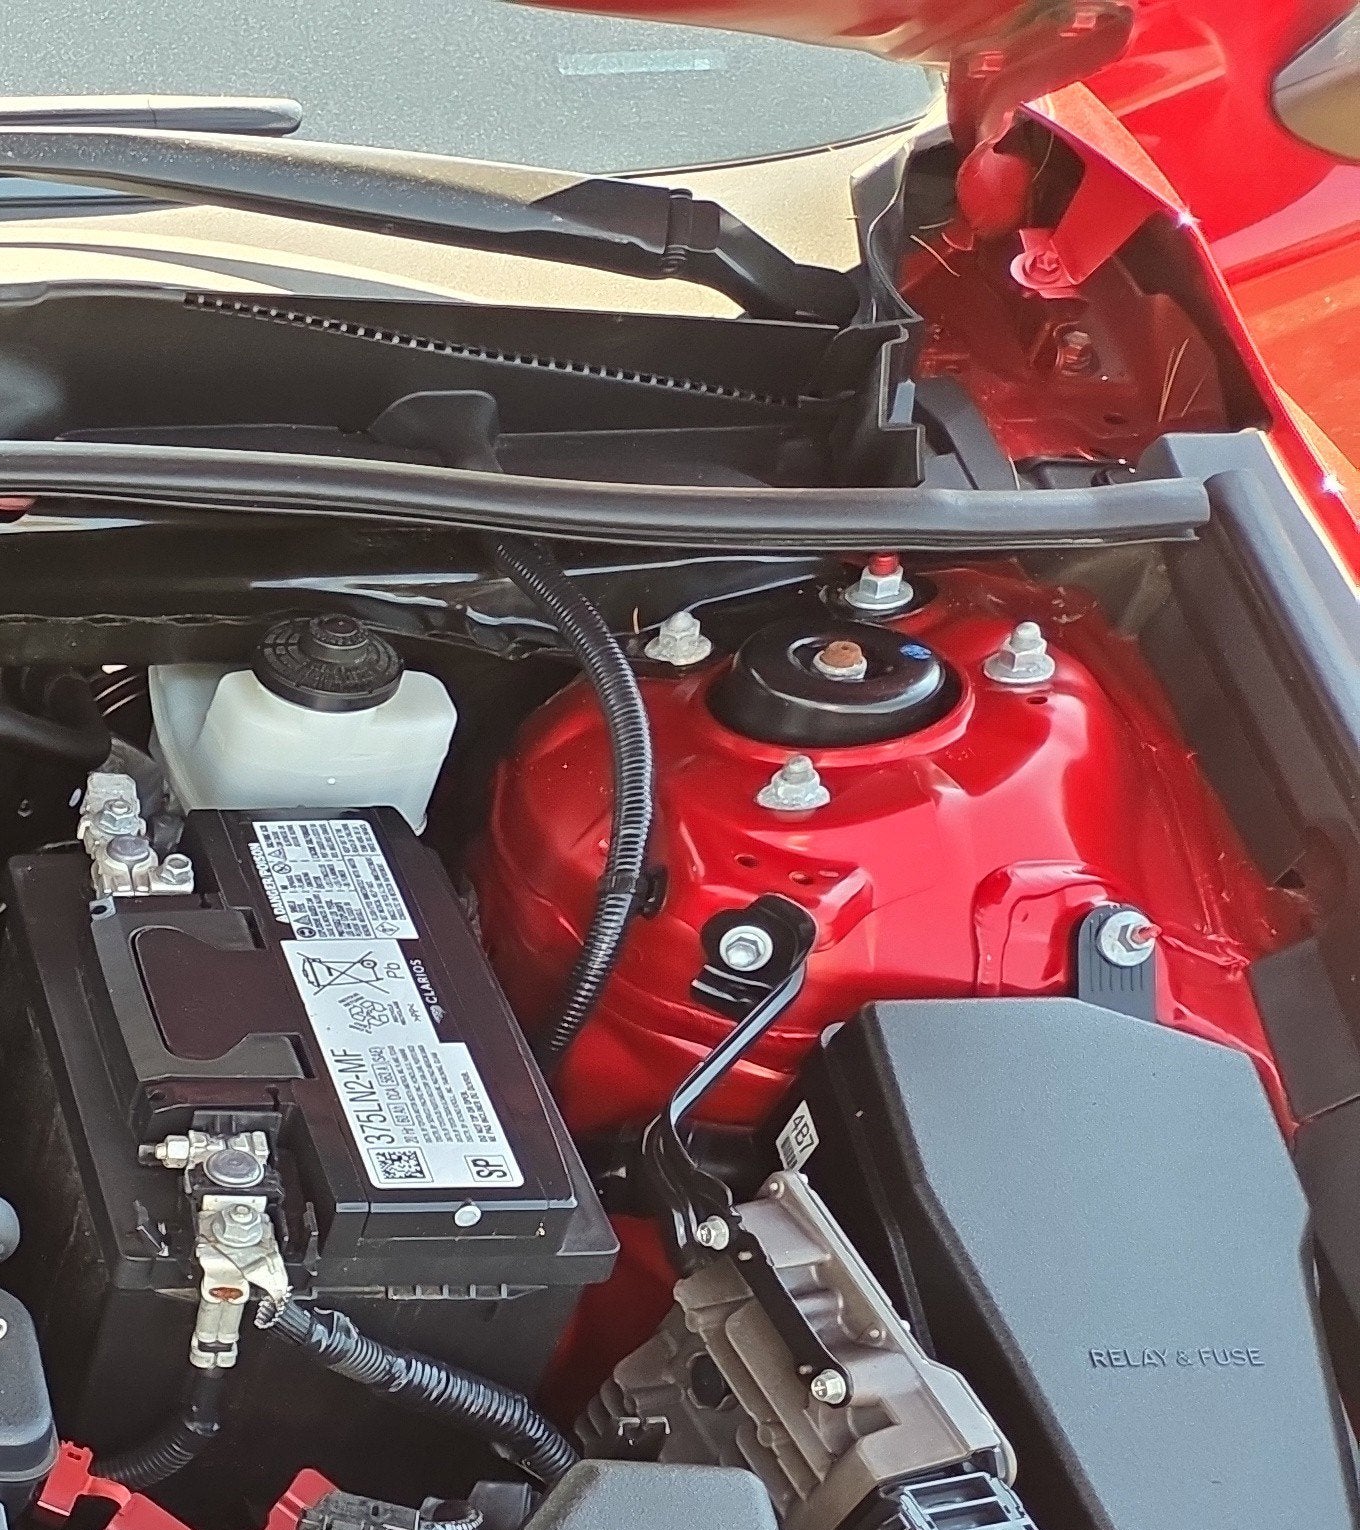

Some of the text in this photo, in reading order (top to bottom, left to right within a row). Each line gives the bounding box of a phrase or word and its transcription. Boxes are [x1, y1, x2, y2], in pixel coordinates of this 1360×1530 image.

[384, 962, 405, 979] Pb
[409, 959, 438, 1005] CLARIOS
[330, 1048, 396, 1145] 375LN2-MF
[792, 1115, 814, 1153] 4B7
[471, 1158, 507, 1178] SP
[1089, 1348, 1266, 1368] RELAY & FUSE
